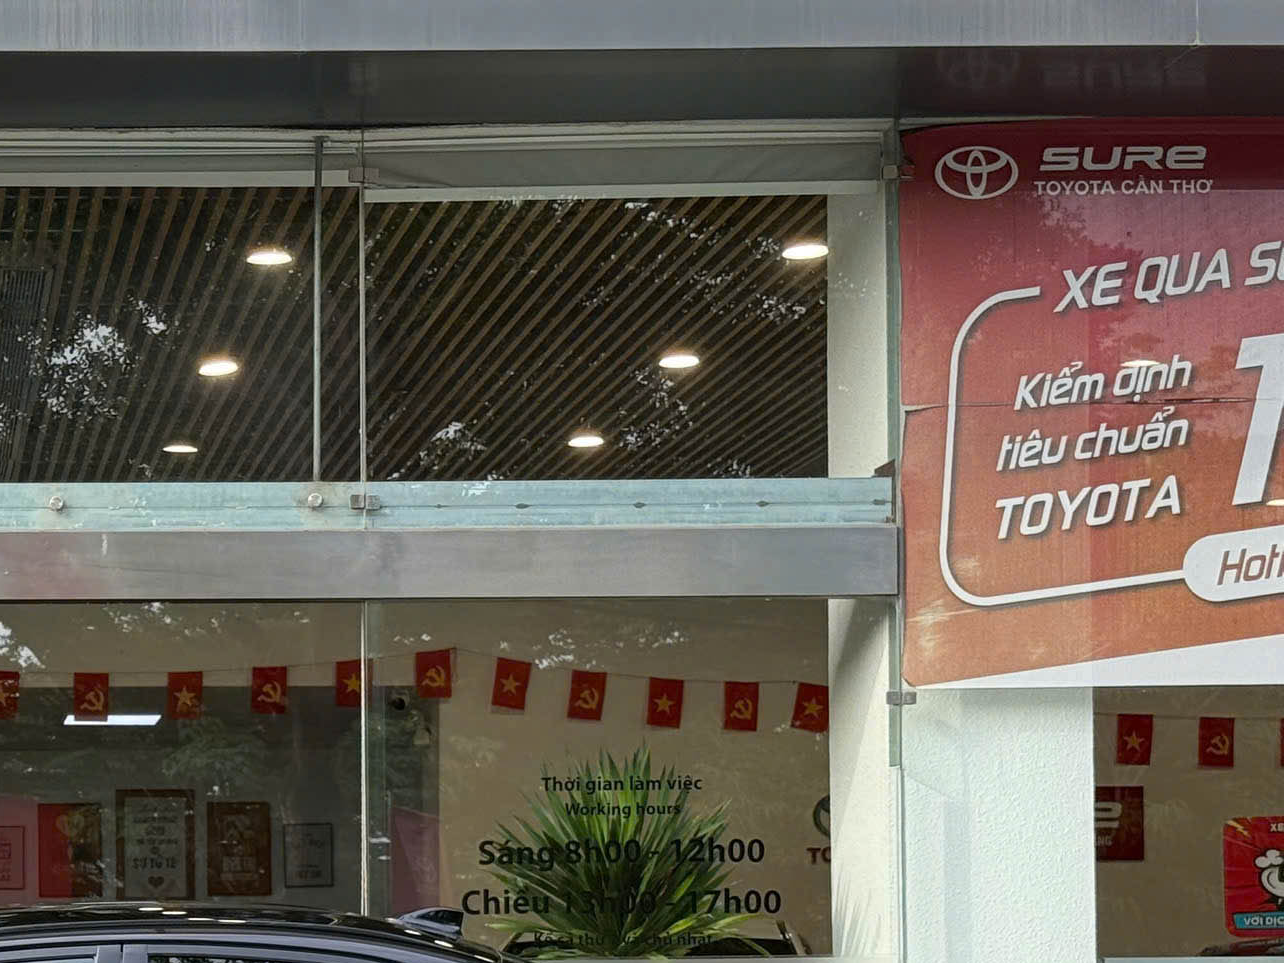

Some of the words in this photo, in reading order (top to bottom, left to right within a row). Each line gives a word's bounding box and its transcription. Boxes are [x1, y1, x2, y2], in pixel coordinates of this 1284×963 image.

[1034, 180, 1116, 195] TOYOTA
[1053, 261, 1127, 313] XE
[1134, 248, 1231, 303] QUA
[1244, 240, 1284, 285] S
[1013, 361, 1106, 411] Kiểm
[996, 429, 1068, 472] tiêu
[1074, 405, 1189, 460] chuẩn
[995, 475, 1181, 540] TOYOTA
[585, 777, 624, 795] gian
[630, 776, 662, 791] làm
[667, 774, 703, 794] việc
[566, 803, 631, 818] Working
[636, 803, 681, 816] hours
[478, 838, 554, 871] Sáng
[566, 839, 641, 864] 8h00
[670, 838, 765, 864] 12h00
[689, 888, 782, 914] 17h00
